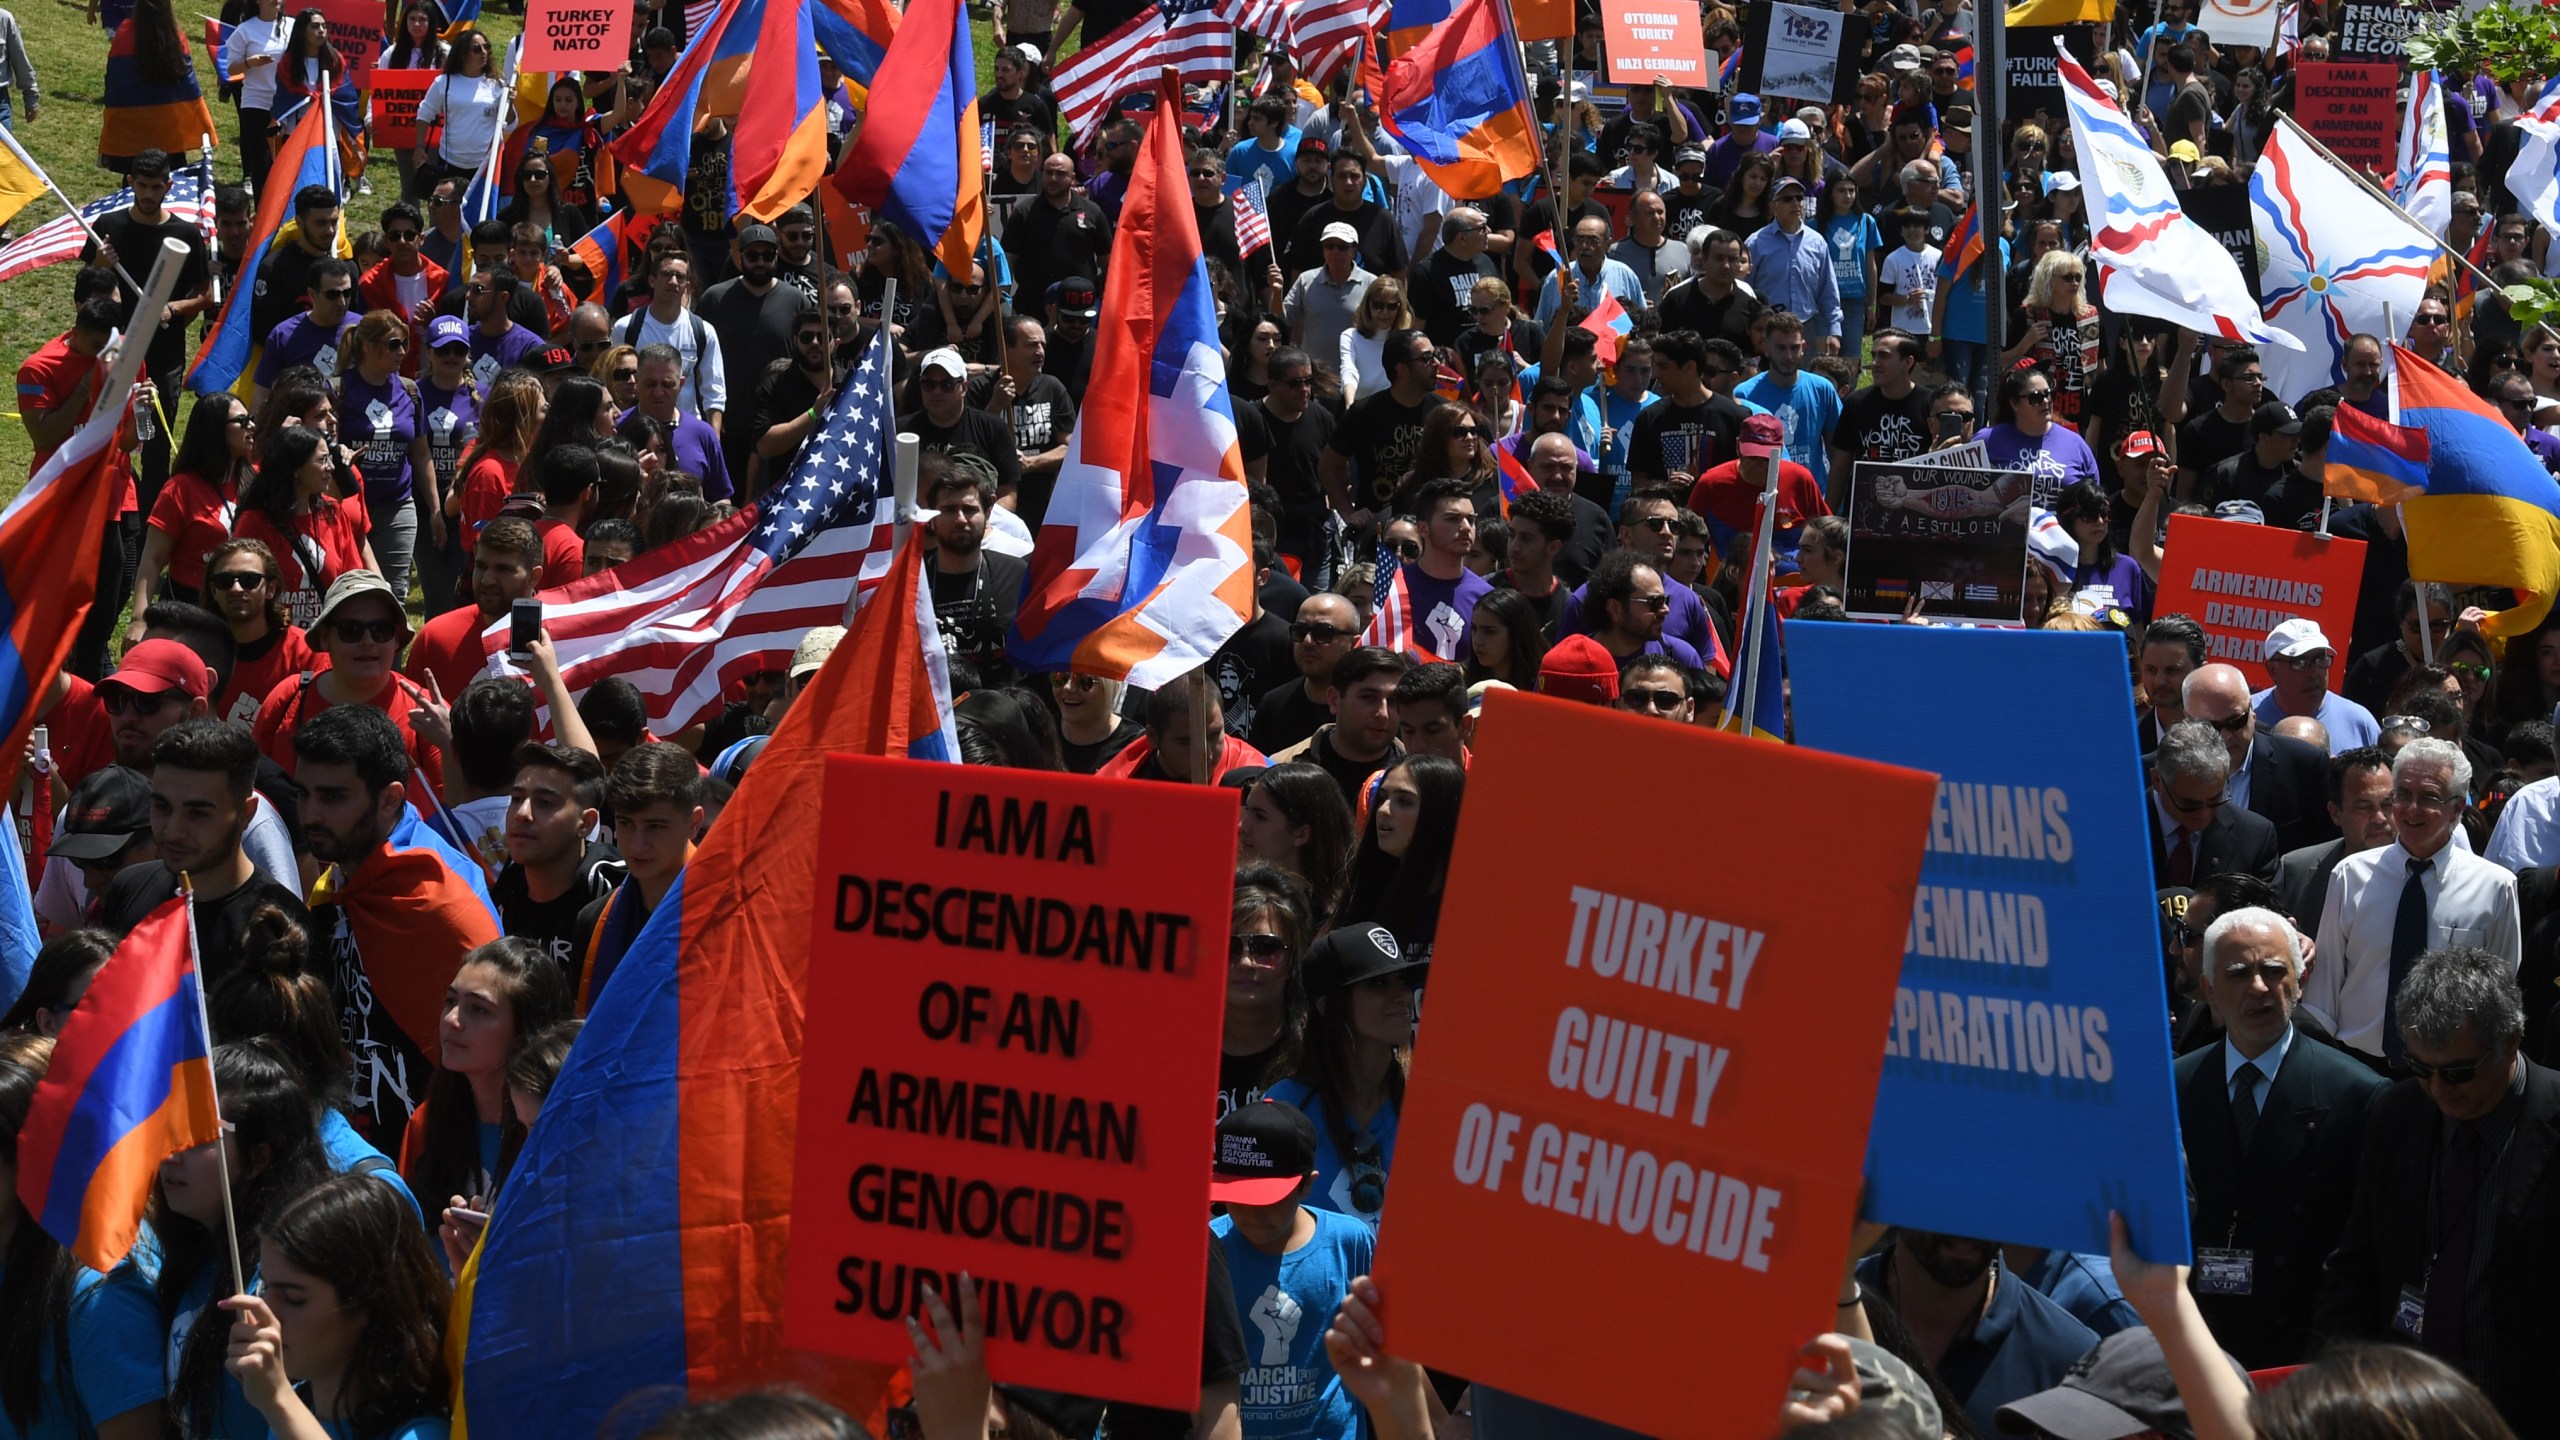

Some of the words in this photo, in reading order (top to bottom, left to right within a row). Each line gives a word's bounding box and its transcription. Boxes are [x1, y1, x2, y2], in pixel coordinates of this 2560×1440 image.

[546, 10, 614, 22] TURKEY
[1624, 12, 1678, 25] OTTOMAN
[2345, 4, 2423, 23] REMEM
[326, 21, 381, 41] ENIANS
[546, 24, 584, 37] OUT
[587, 23, 610, 36] OF
[1631, 28, 1674, 40] TURKEY
[553, 38, 601, 51] NATO
[1616, 57, 1642, 70] NAZI
[1644, 58, 1697, 71] GERMANY
[2005, 56, 2058, 71] #TURK
[2328, 70, 2333, 81] I
[2335, 70, 2356, 81] AM
[2359, 70, 2368, 81] A
[2305, 86, 2391, 98] DESCENDANT
[2328, 103, 2345, 114] OF
[2348, 104, 2368, 114] AN
[2312, 120, 2383, 131] ARMENIAN
[701, 210, 725, 231] 191
[1679, 207, 1704, 221] OUR
[1834, 261, 1855, 270] ARCH
[438, 321, 463, 335] SWAG
[2052, 326, 2081, 342] OUR
[1880, 413, 1914, 434] OUR
[1394, 424, 1425, 442] OUR
[1859, 428, 1924, 452] WOUNDS
[352, 440, 395, 451] MARCH
[1939, 446, 1984, 469] GUILTY
[2019, 447, 2057, 464] OUR
[1912, 469, 1938, 485] OUR
[1944, 471, 1992, 486] WOUNDS
[1999, 459, 2067, 480] WOUNDS
[1931, 491, 1970, 512] 1915
[2190, 567, 2323, 607] ARMENIANS
[2204, 602, 2299, 632] DEMAN
[934, 790, 950, 848] I
[959, 793, 1047, 860] AM
[1057, 805, 1096, 866] A
[1922, 782, 2073, 863] ENIANS
[2160, 894, 2189, 917] 19
[833, 875, 1190, 974] DESCENDANT
[1565, 885, 1765, 1011] TURKEY
[918, 980, 990, 1044] OF
[1001, 993, 1081, 1059] AN
[1548, 1006, 1730, 1128] GUILTY
[846, 1067, 1138, 1165] ARMENIAN
[1233, 1149, 1267, 1160] FORGED
[1238, 1158, 1274, 1168] KUTURE
[1453, 1102, 1521, 1193] OF
[1522, 1121, 1782, 1273] GENOCIDE
[848, 1163, 1125, 1260] GENOCIDE
[2212, 1281, 2238, 1290] VIP
[834, 1256, 1125, 1360] SURVIVOR
[1243, 1382, 1316, 1405] JUSTICE
[1240, 1411, 1273, 1421] menian
